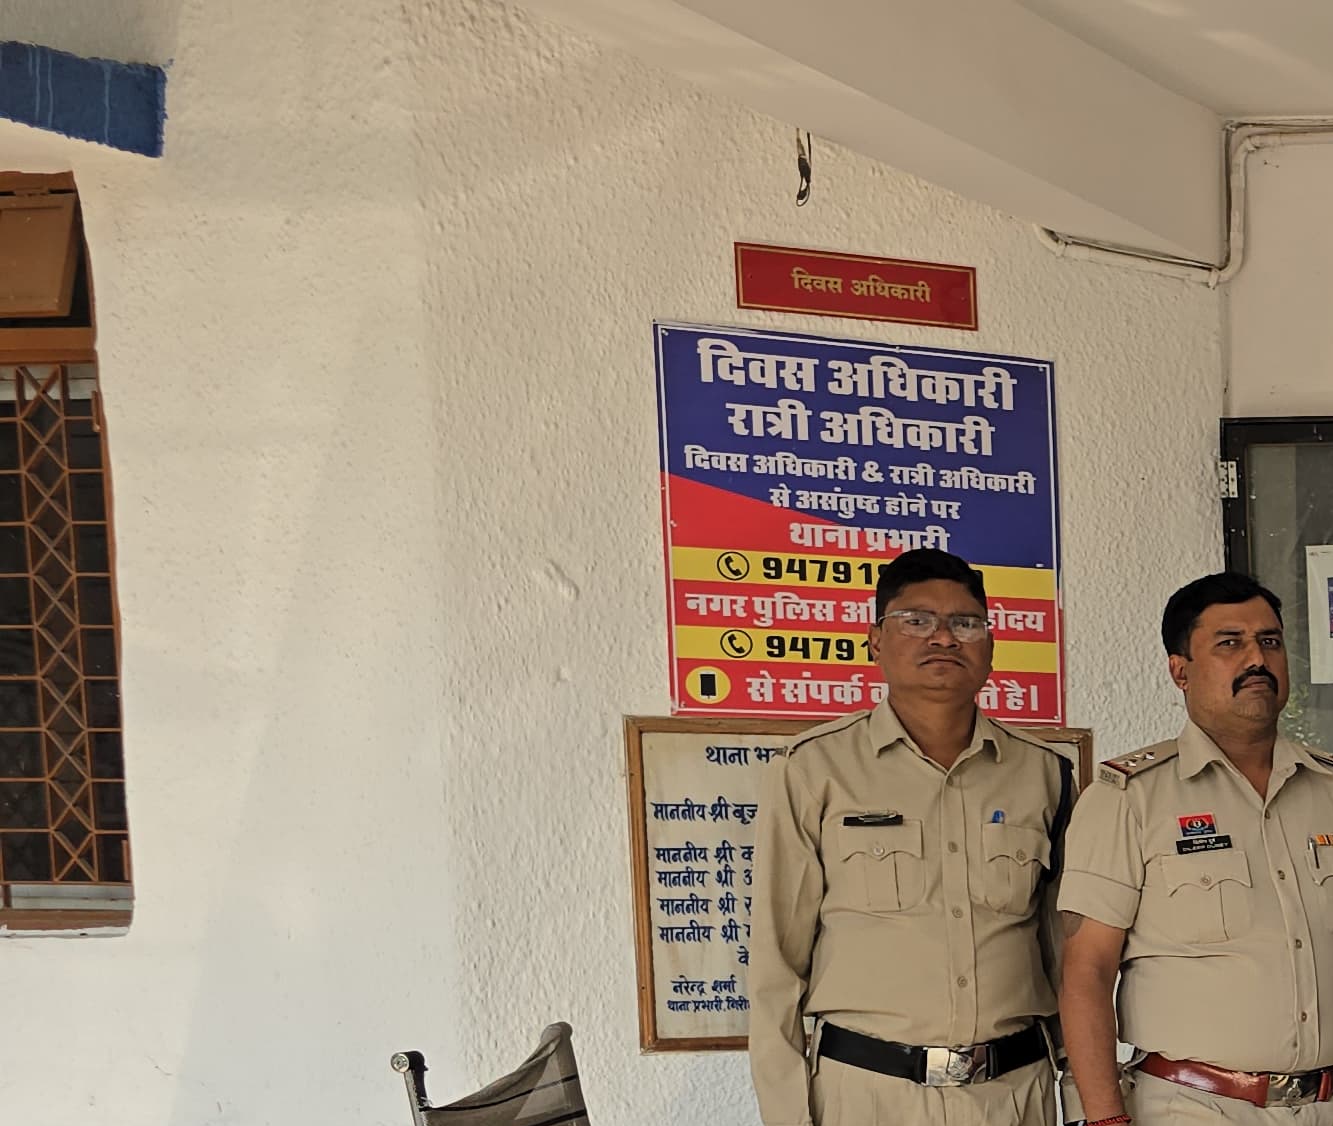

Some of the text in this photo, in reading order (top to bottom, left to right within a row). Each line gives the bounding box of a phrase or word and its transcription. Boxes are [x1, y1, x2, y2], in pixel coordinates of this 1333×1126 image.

[791, 267, 931, 302] दिवस अधिकारी
[697, 338, 1017, 410] दिवस अधिकारी
[726, 399, 995, 456] रात्री अधिकारी
[684, 445, 1036, 494] दिवस अधिकारी & रात्री अधिकारी
[769, 483, 961, 519] से असंतुष्ट होने पर
[790, 523, 861, 549] थाना
[685, 593, 749, 618] नगर
[752, 592, 837, 627] पुलिस
[766, 635, 874, 662] 94791
[746, 670, 776, 702] से
[779, 671, 864, 705] संपर्क
[1000, 679, 1039, 712] है।
[706, 746, 750, 766] थाना
[650, 798, 707, 821] माननीय
[708, 796, 731, 823] श्री
[654, 841, 708, 864] माननीय
[714, 840, 736, 864] श्री
[671, 974, 737, 996] नरेन्द्र शर्मा
